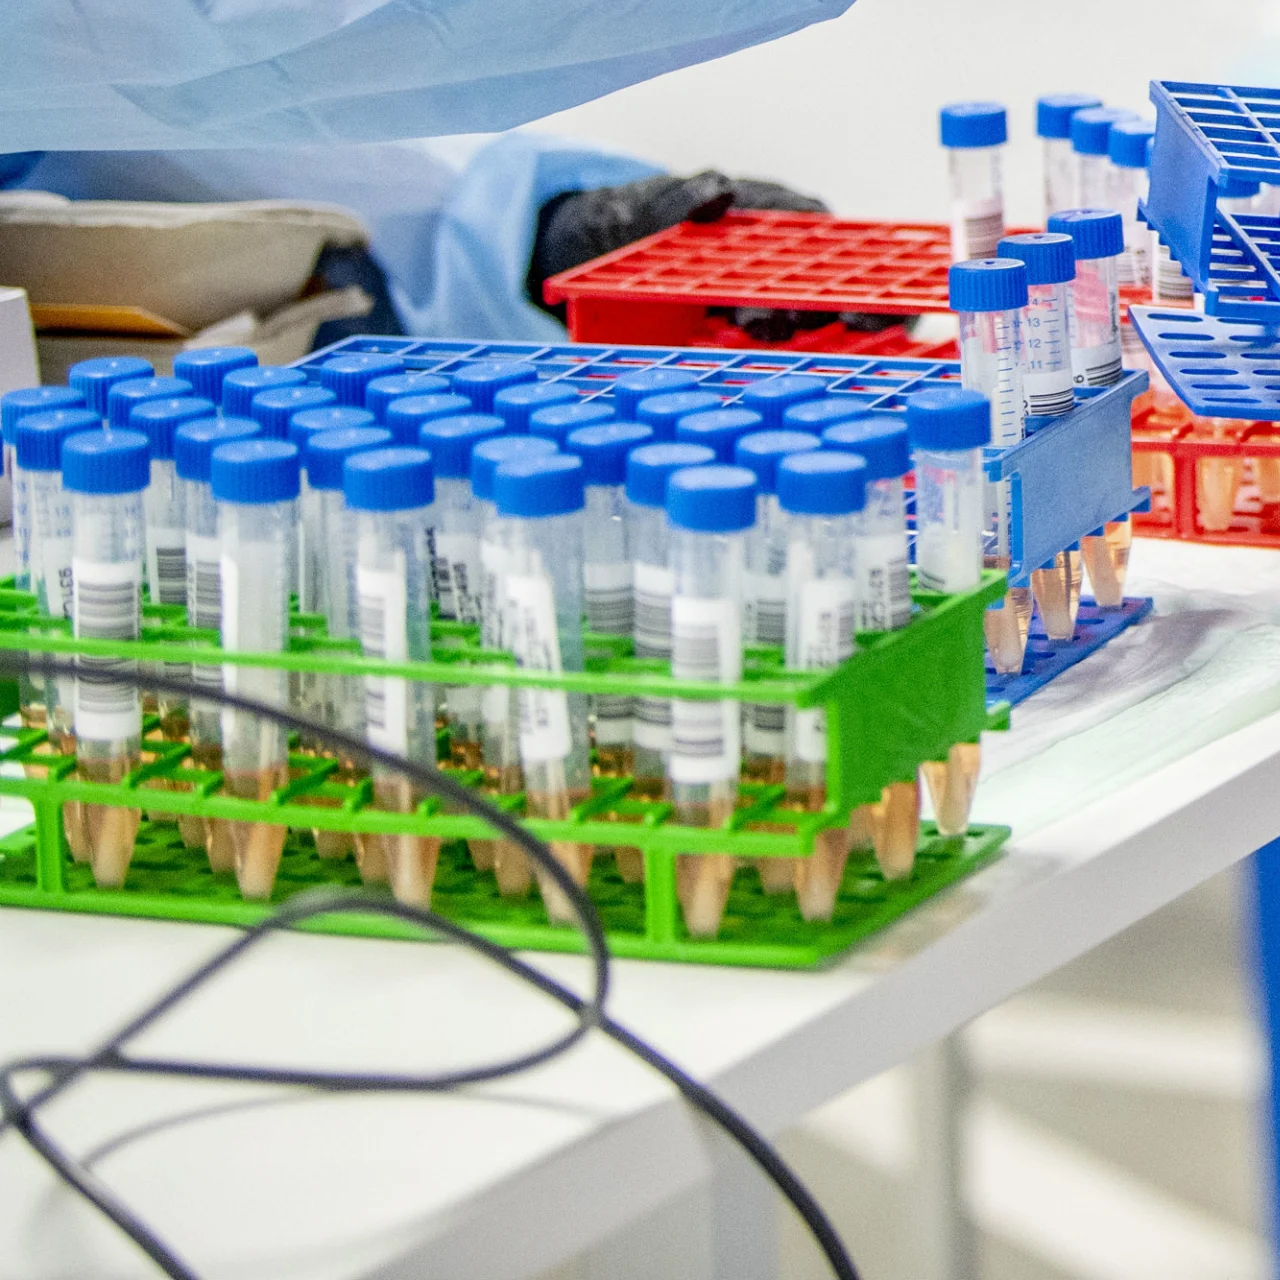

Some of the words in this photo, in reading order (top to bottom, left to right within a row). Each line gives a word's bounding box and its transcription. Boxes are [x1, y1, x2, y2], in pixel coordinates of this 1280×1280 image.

[1027, 317, 1040, 327] 13
[1028, 338, 1041, 348] 12
[1030, 360, 1042, 369] 11
